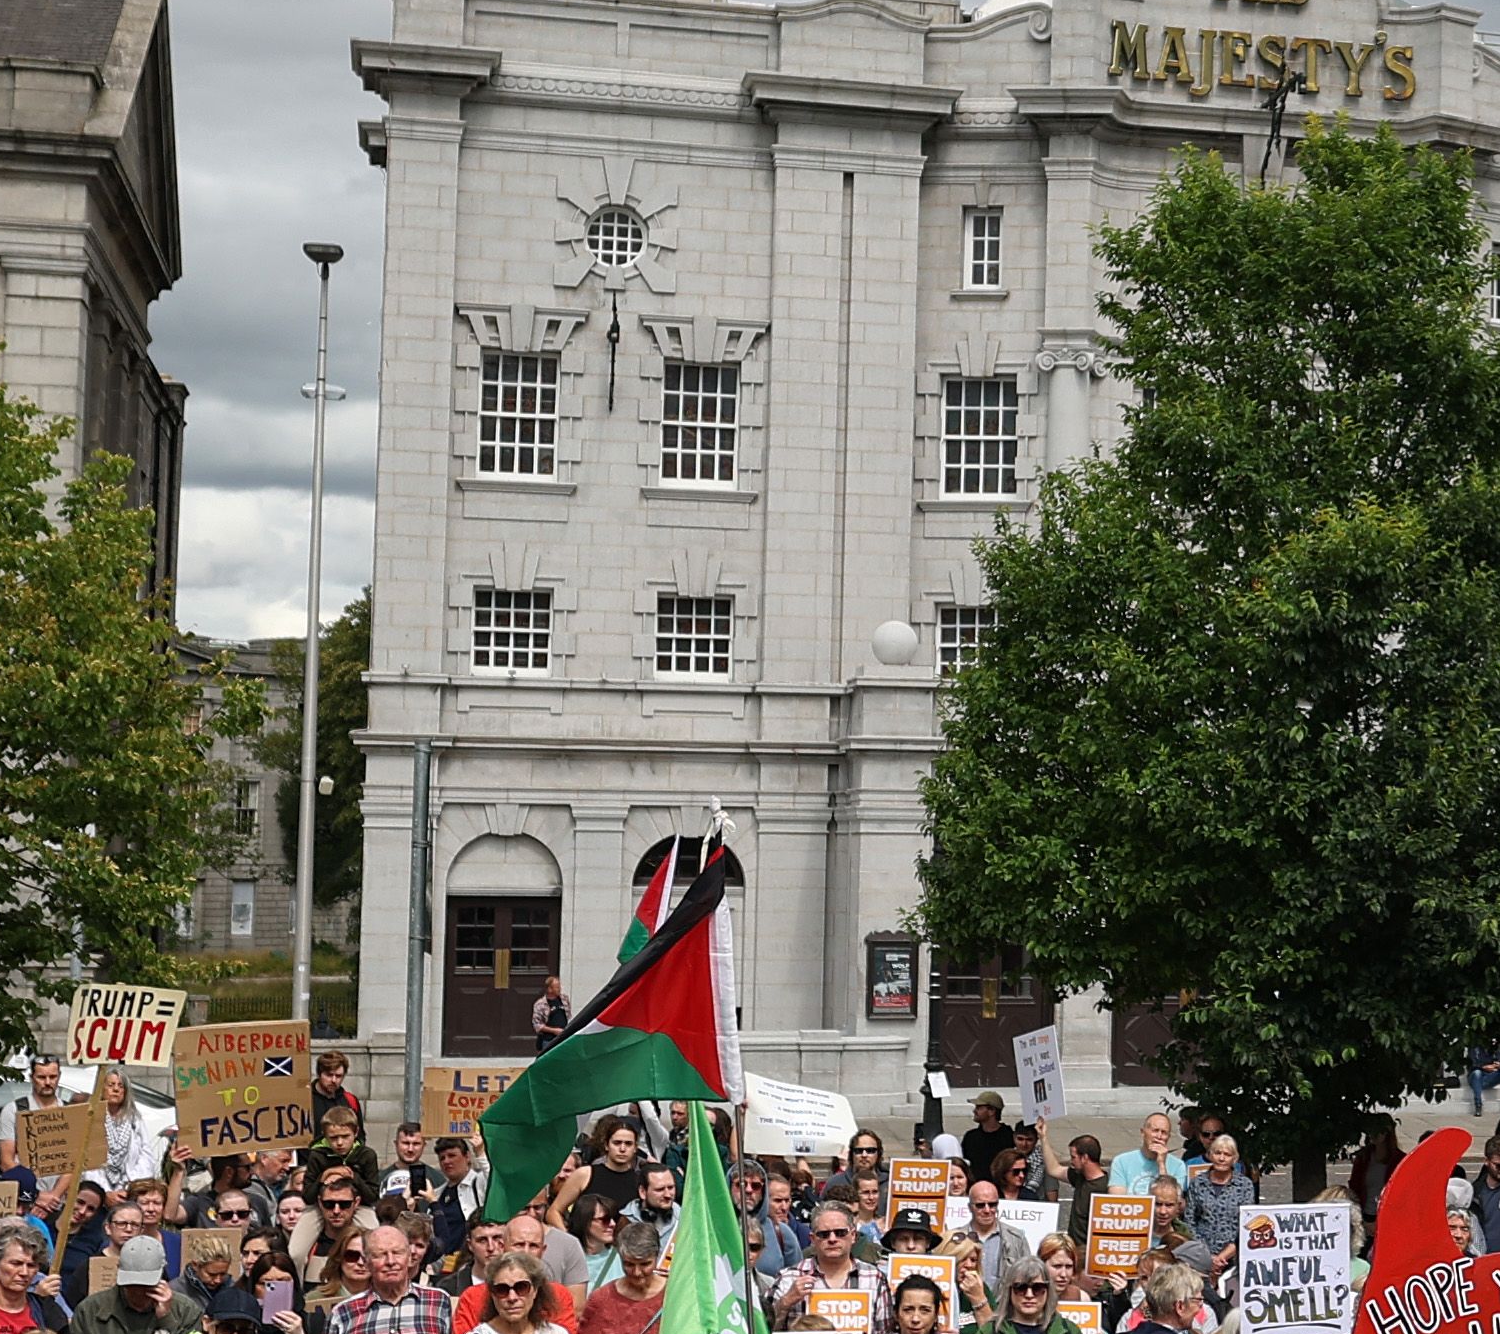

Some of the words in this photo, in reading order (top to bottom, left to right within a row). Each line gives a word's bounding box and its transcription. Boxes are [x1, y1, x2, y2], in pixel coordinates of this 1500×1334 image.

[1108, 19, 1417, 100] MAJESTY'S
[79, 988, 155, 1017] TRUMP
[71, 1018, 167, 1061] SCUM
[453, 1070, 511, 1092] LET
[216, 1086, 260, 1107] TO
[448, 1092, 485, 1109] LOVE
[201, 1103, 313, 1148] FASCISM
[899, 1167, 942, 1180] STOP
[892, 1180, 947, 1194] TRUMP
[1100, 1201, 1145, 1217] STOP
[1093, 1217, 1149, 1233] TRUMP
[1274, 1211, 1329, 1233] WHAT
[1098, 1237, 1140, 1252] FREE
[1277, 1235, 1292, 1251] IS
[1297, 1231, 1341, 1252] THAT
[1243, 1255, 1327, 1288] AWFUL
[817, 1300, 862, 1315] STOP
